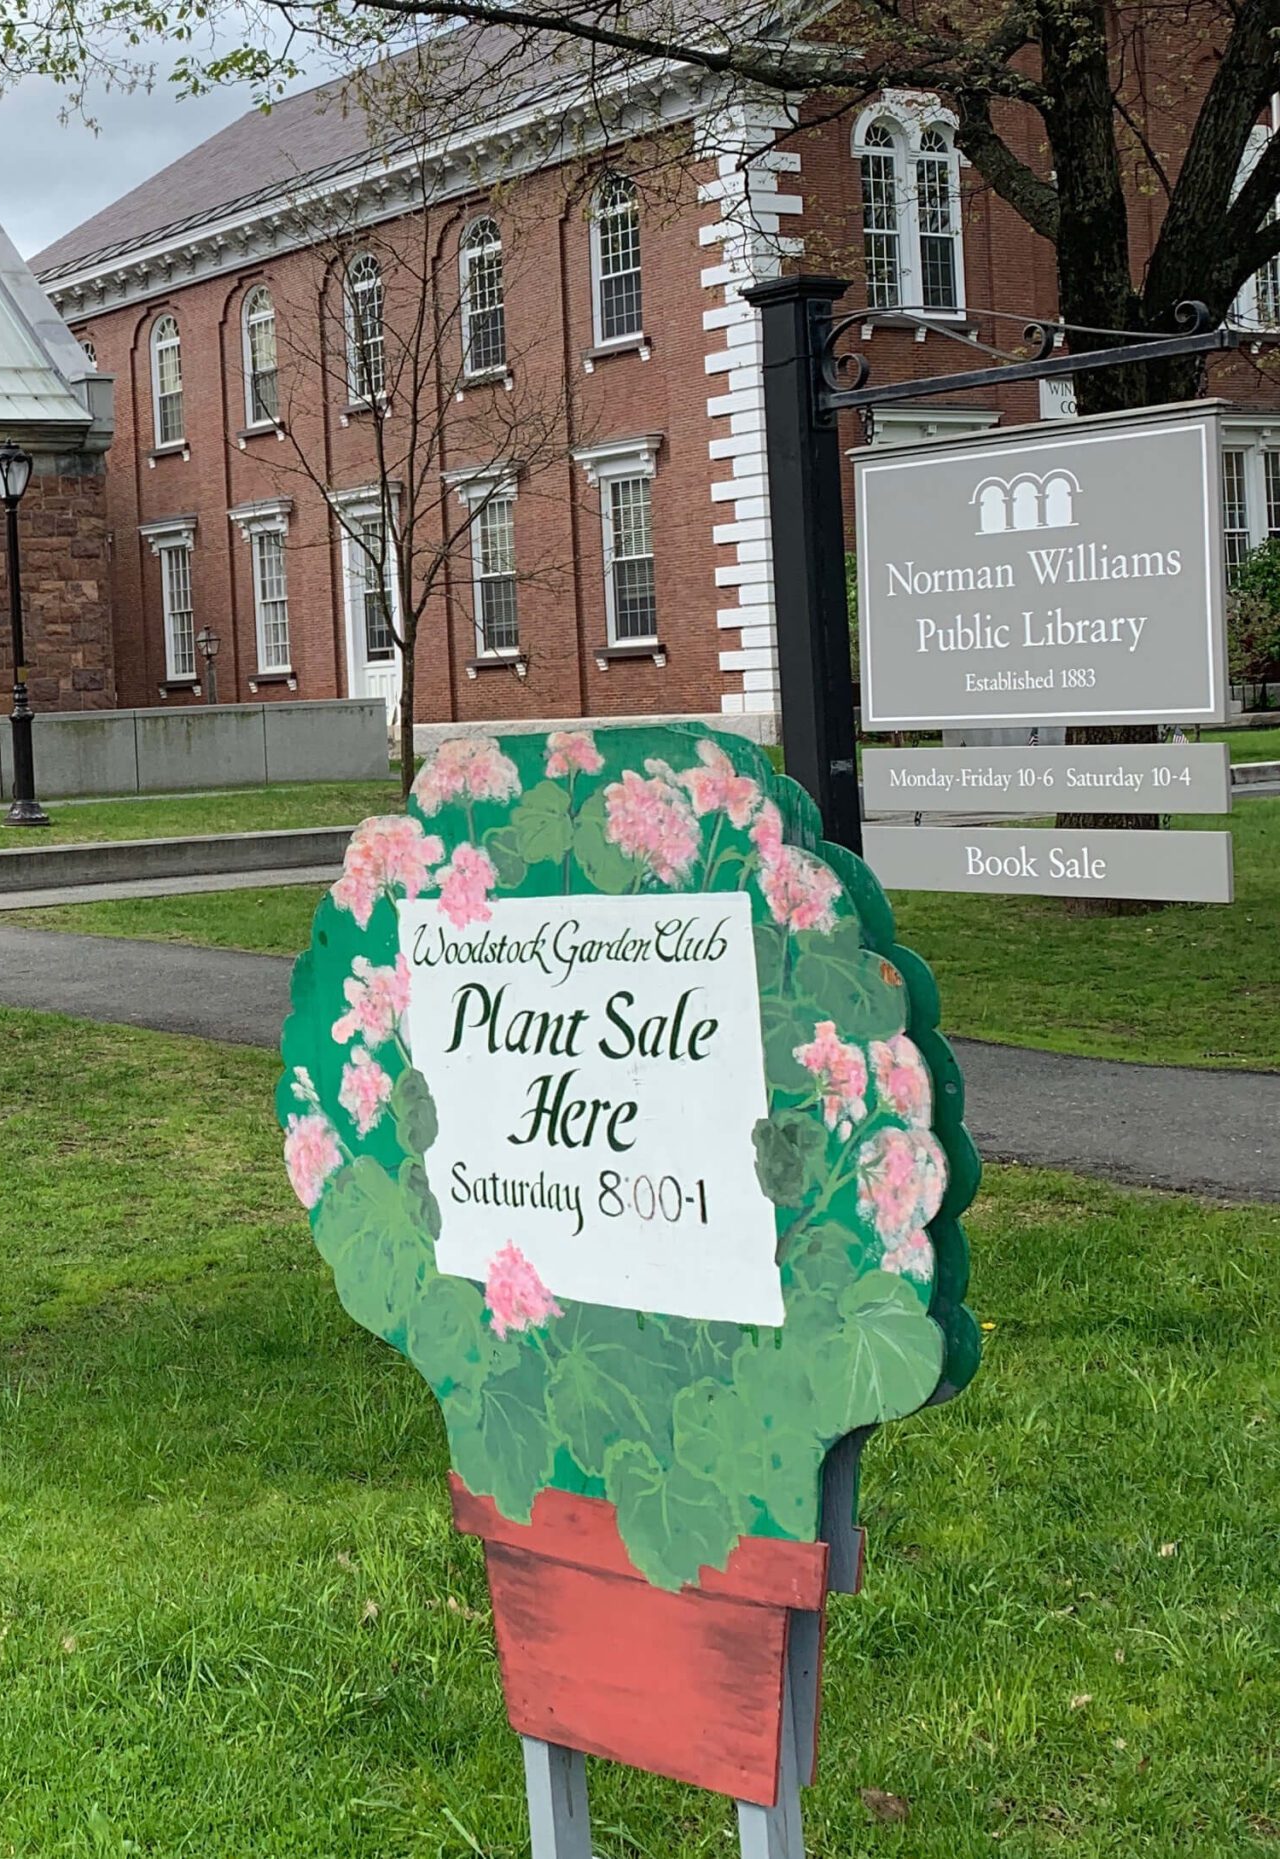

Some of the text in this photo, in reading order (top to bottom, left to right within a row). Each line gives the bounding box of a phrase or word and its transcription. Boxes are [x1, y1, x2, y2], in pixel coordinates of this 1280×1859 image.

[885, 542, 1182, 597] Norman Williams
[916, 607, 1148, 653] Public Library
[965, 668, 1097, 692] Established 1883
[889, 766, 1192, 792] Monday-Friday 10-6 Saturday 10-4
[964, 845, 1106, 879] Book Sale
[412, 916, 732, 988] Woodstock Garden Club
[443, 981, 719, 1062] Plant Sale
[506, 1068, 639, 1153] Here
[450, 1161, 585, 1237] Saturday
